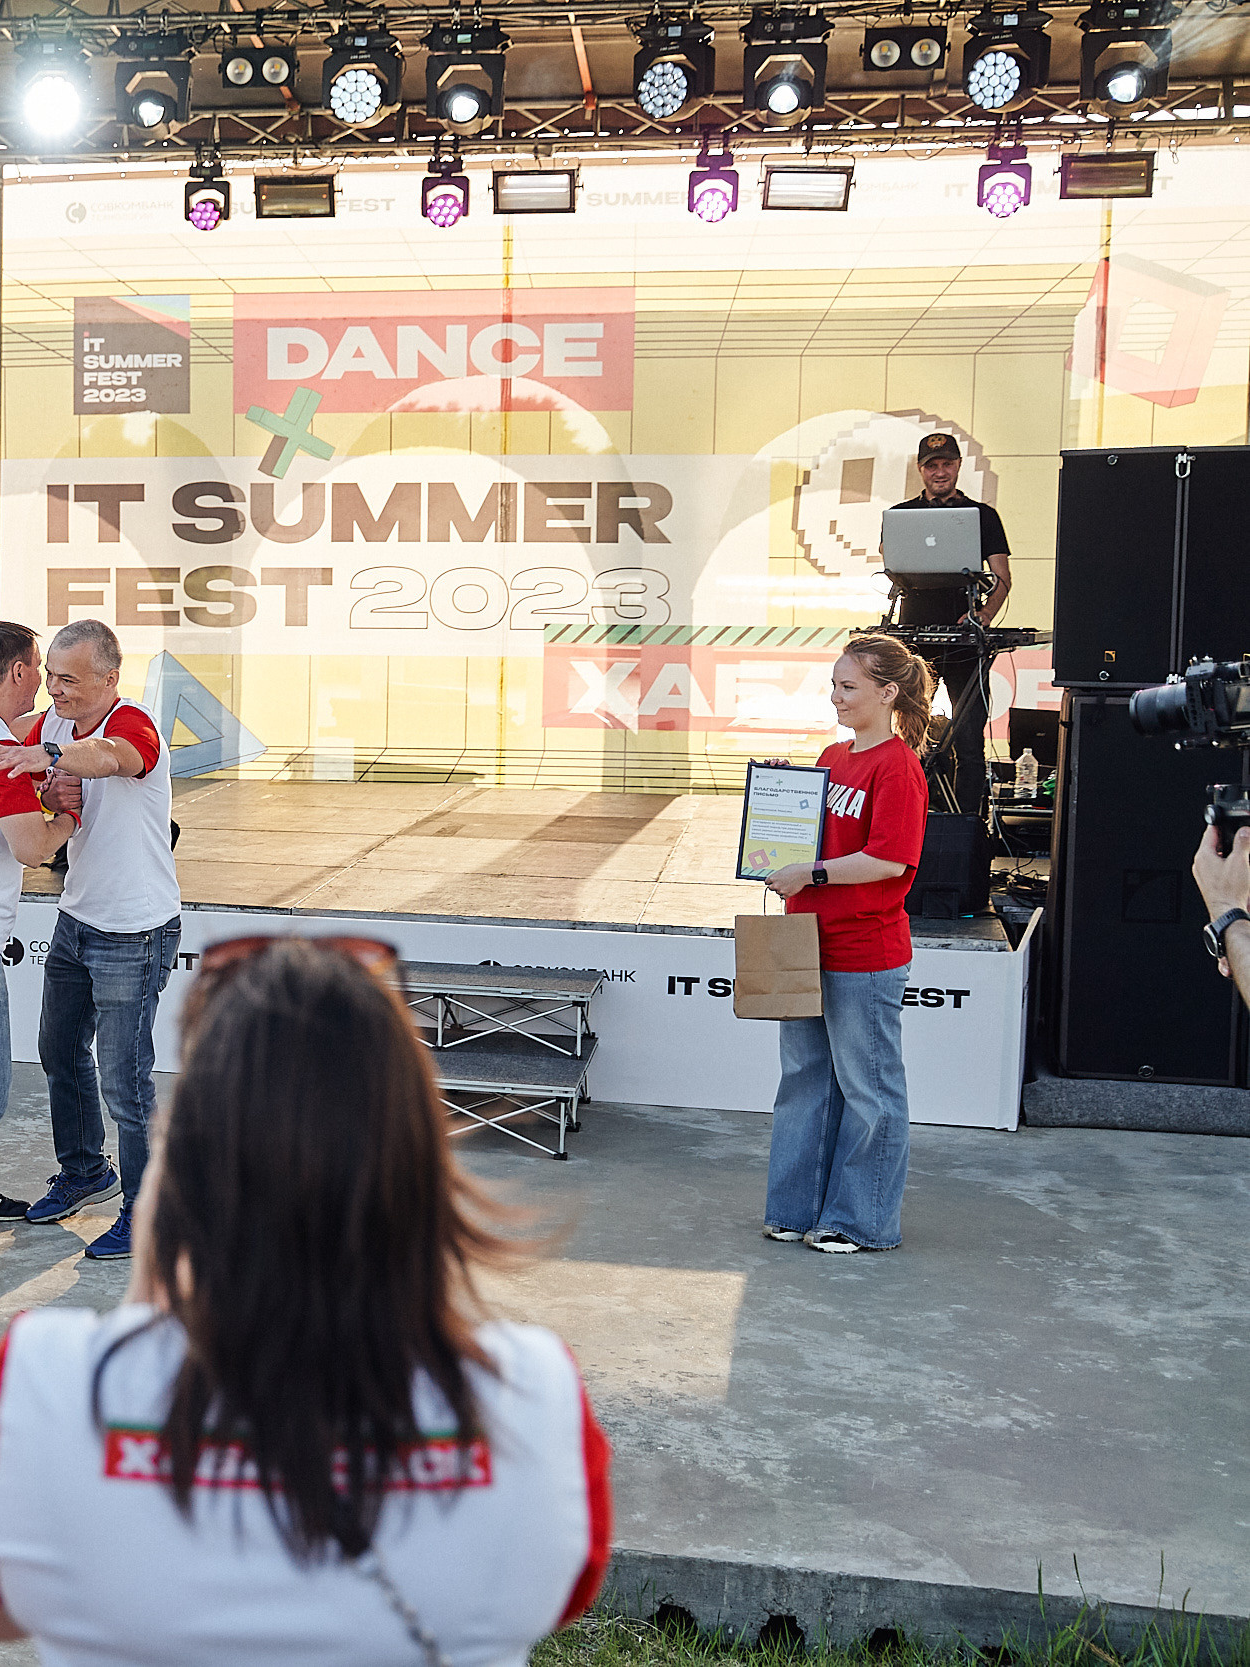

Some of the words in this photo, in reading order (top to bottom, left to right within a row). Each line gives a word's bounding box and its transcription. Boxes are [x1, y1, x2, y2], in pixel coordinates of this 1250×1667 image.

[945, 183, 969, 198] IT
[266, 322, 605, 380] DANCE
[83, 353, 183, 369] SUMMER
[83, 371, 143, 386] FEST
[83, 388, 147, 403] 2023
[46, 483, 145, 543] IT
[171, 481, 673, 544] SUMMER
[46, 566, 333, 627] FEST
[349, 566, 672, 631] 2023
[754, 786, 818, 796] БЛАГОДАРСТВЕННОЕ
[667, 976, 700, 996] IT
[900, 986, 971, 1009] EST
